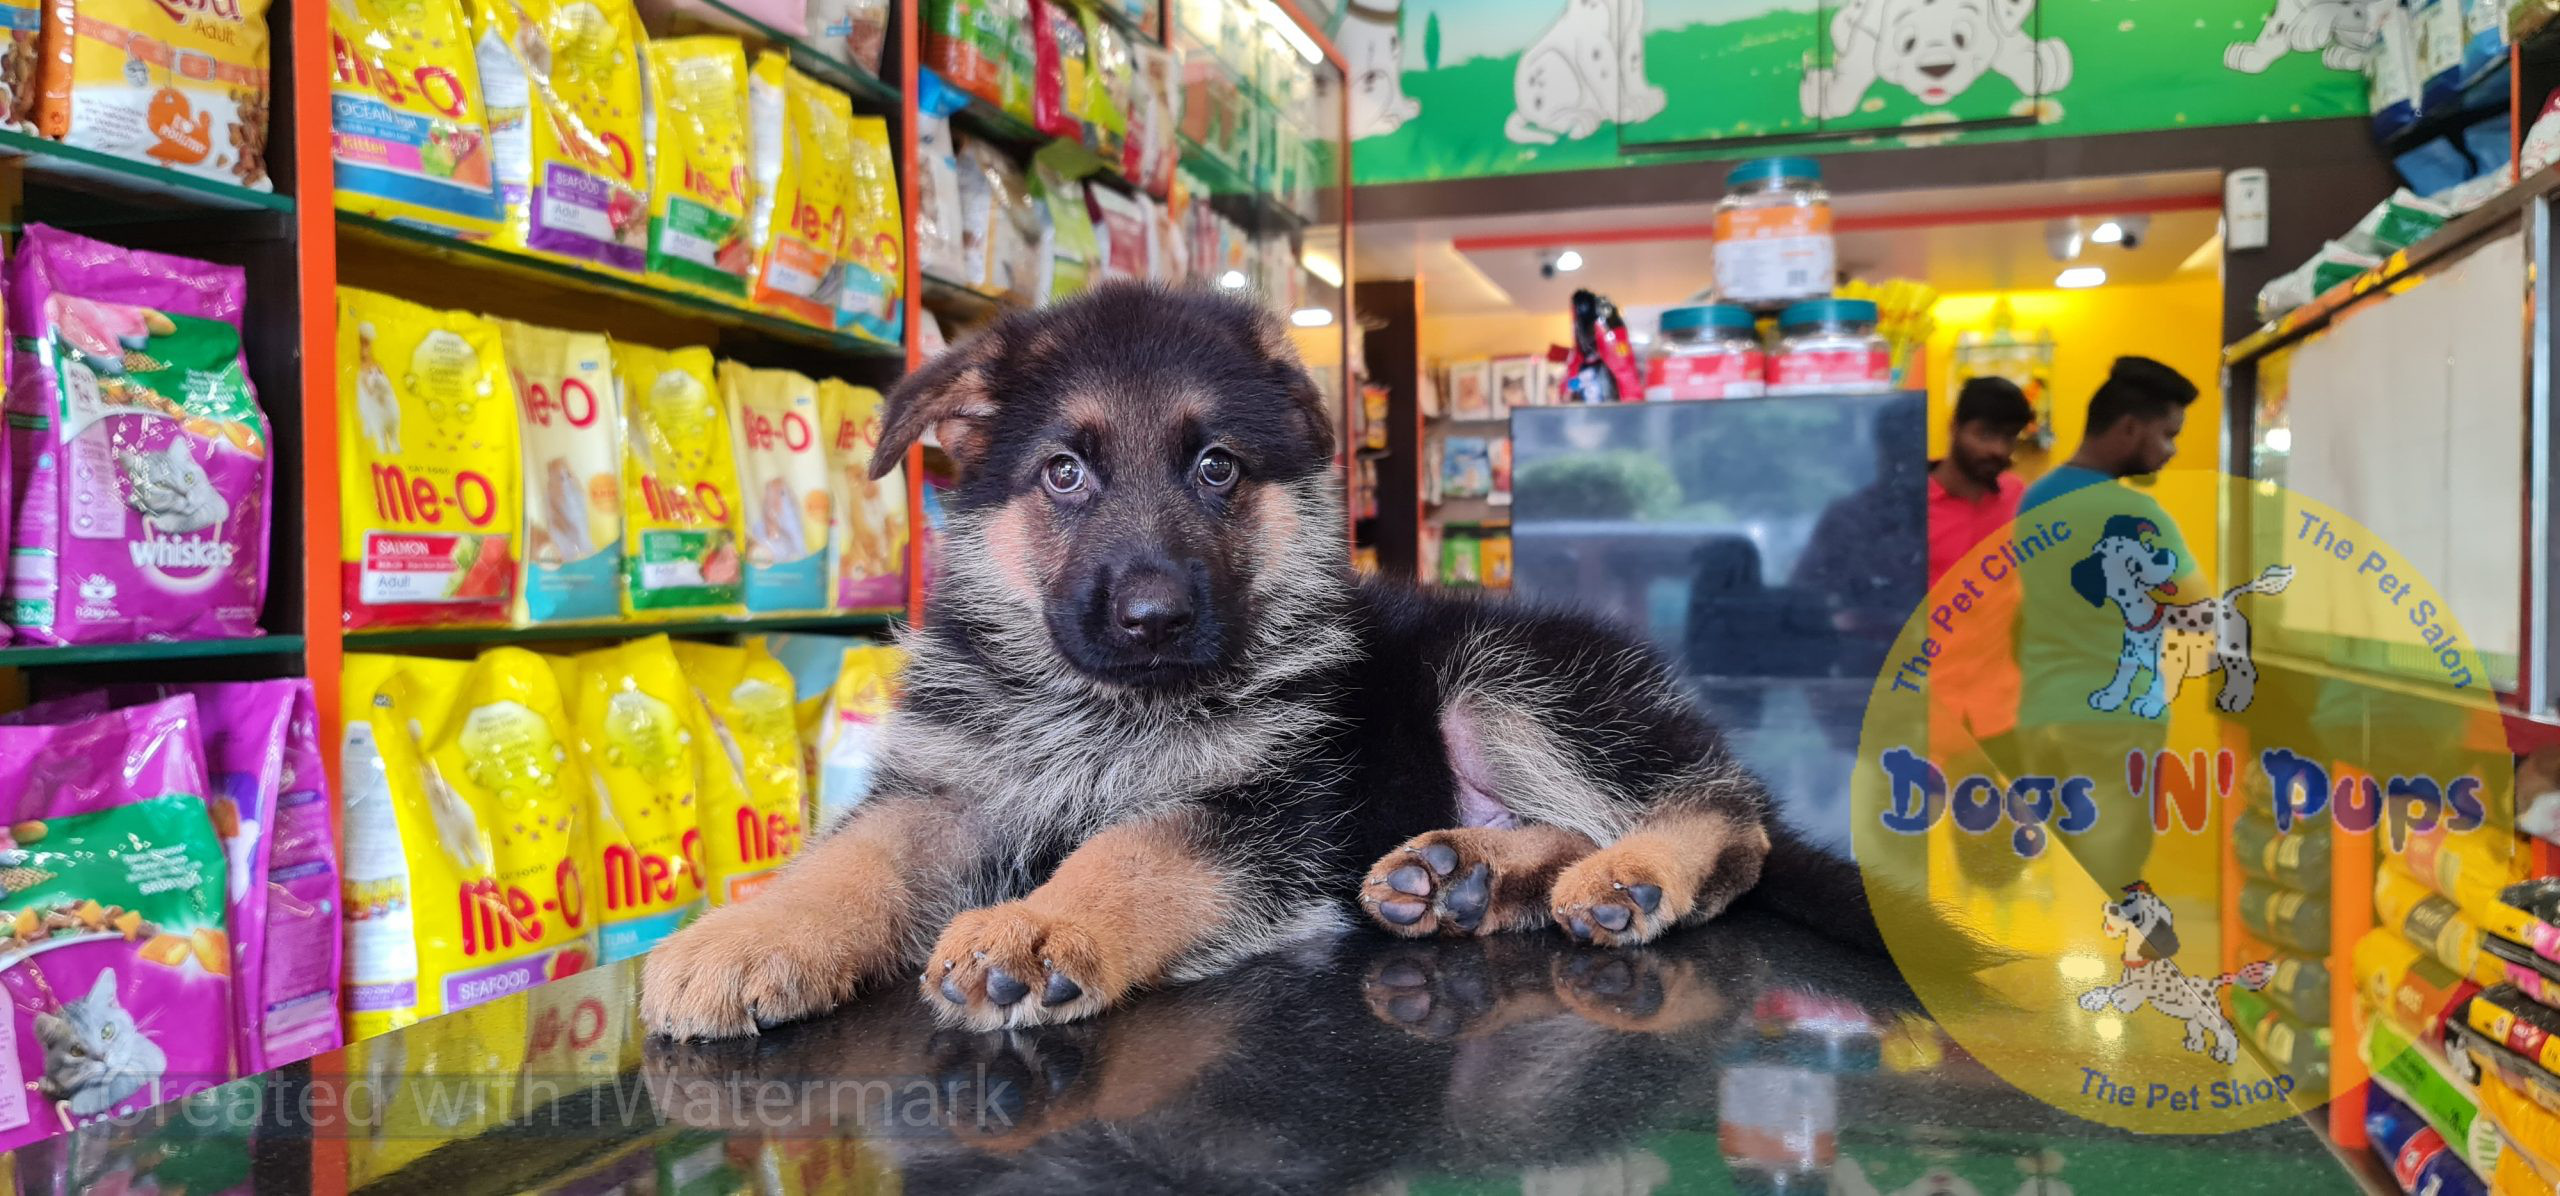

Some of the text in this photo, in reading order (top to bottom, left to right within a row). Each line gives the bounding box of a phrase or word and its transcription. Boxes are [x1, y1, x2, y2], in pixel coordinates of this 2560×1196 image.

[129, 536, 234, 569] whiskas
[377, 538, 431, 556] SALMON
[459, 968, 530, 1001] SEAFOOD
